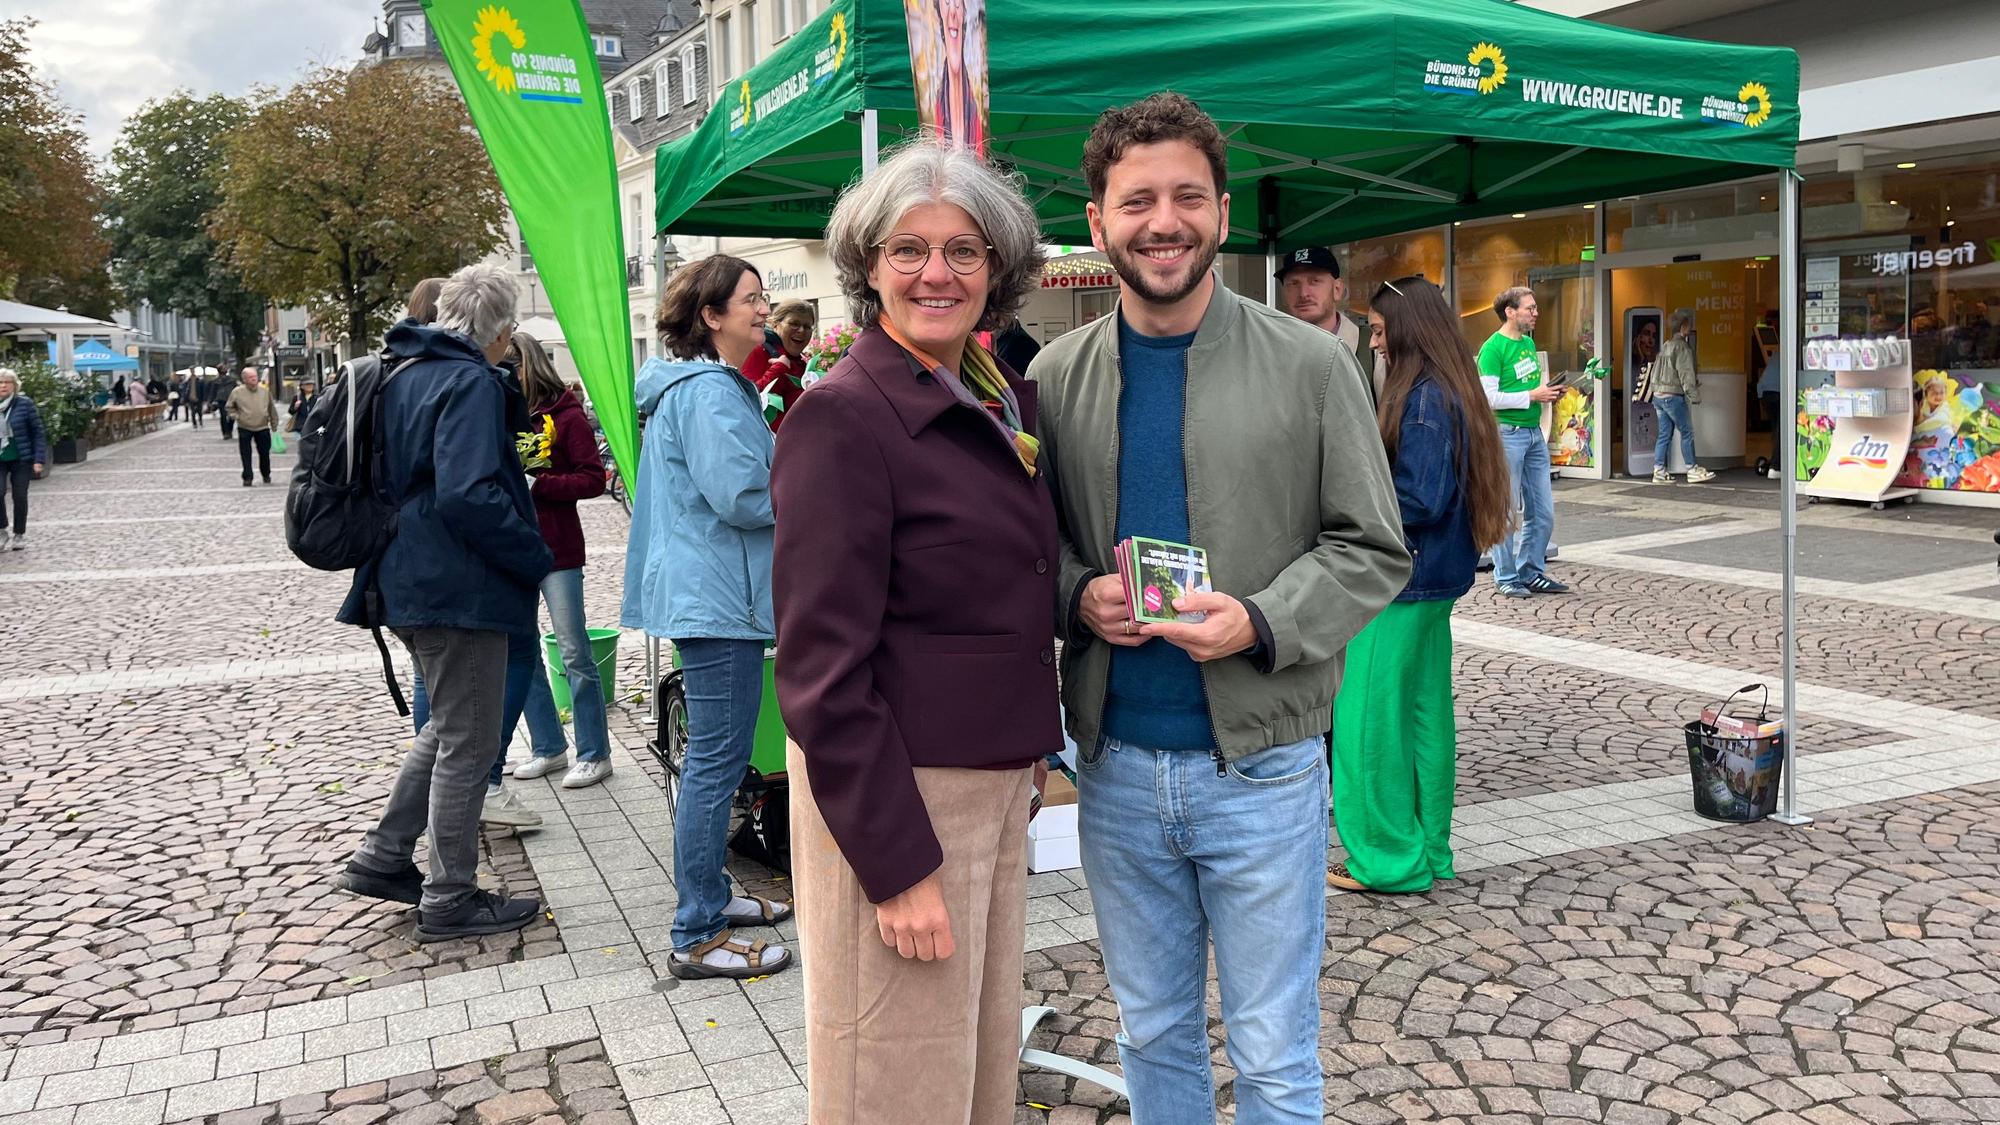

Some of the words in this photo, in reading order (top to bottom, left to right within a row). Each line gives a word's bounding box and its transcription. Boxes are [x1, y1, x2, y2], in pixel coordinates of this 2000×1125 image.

[1426, 59, 1466, 77] BÜNDNIS
[1467, 66, 1480, 78] 90
[1424, 73, 1440, 85] DIE
[1442, 74, 1479, 90] GRÜNEN
[754, 67, 808, 122] WWW.GRUENE.DE
[1522, 78, 1684, 120] WWW.GRUENE.DE
[1702, 95, 1737, 111] BÜNDNIS
[1737, 102, 1748, 113] 90
[1701, 107, 1715, 118] DIE
[1716, 109, 1746, 124] GRÜNEN
[1041, 274, 1113, 288] APOTHEKE
[1687, 271, 1712, 280] HIER
[1850, 436, 1890, 458] dm
